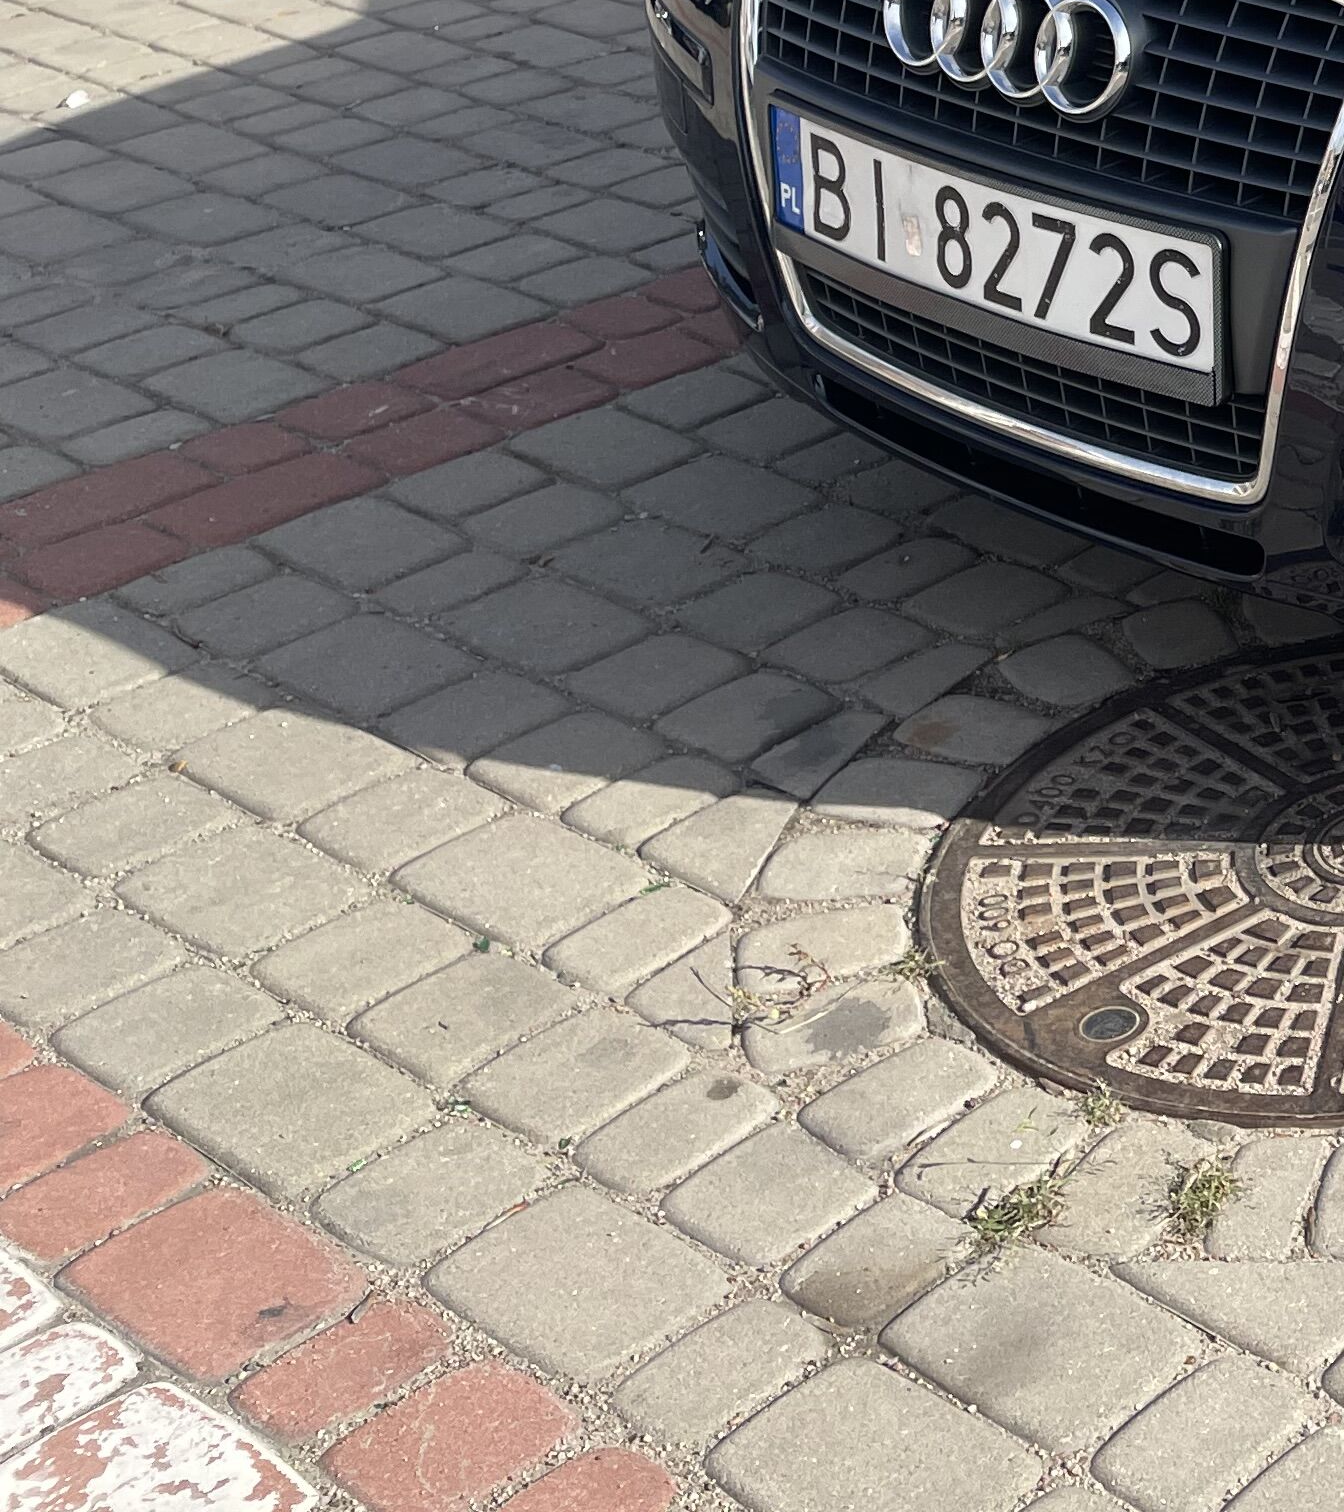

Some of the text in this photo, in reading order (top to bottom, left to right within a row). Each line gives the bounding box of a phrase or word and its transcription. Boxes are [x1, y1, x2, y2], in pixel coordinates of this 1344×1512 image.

[780, 181, 801, 214] PL
[809, 132, 1202, 358] BI 8272S
